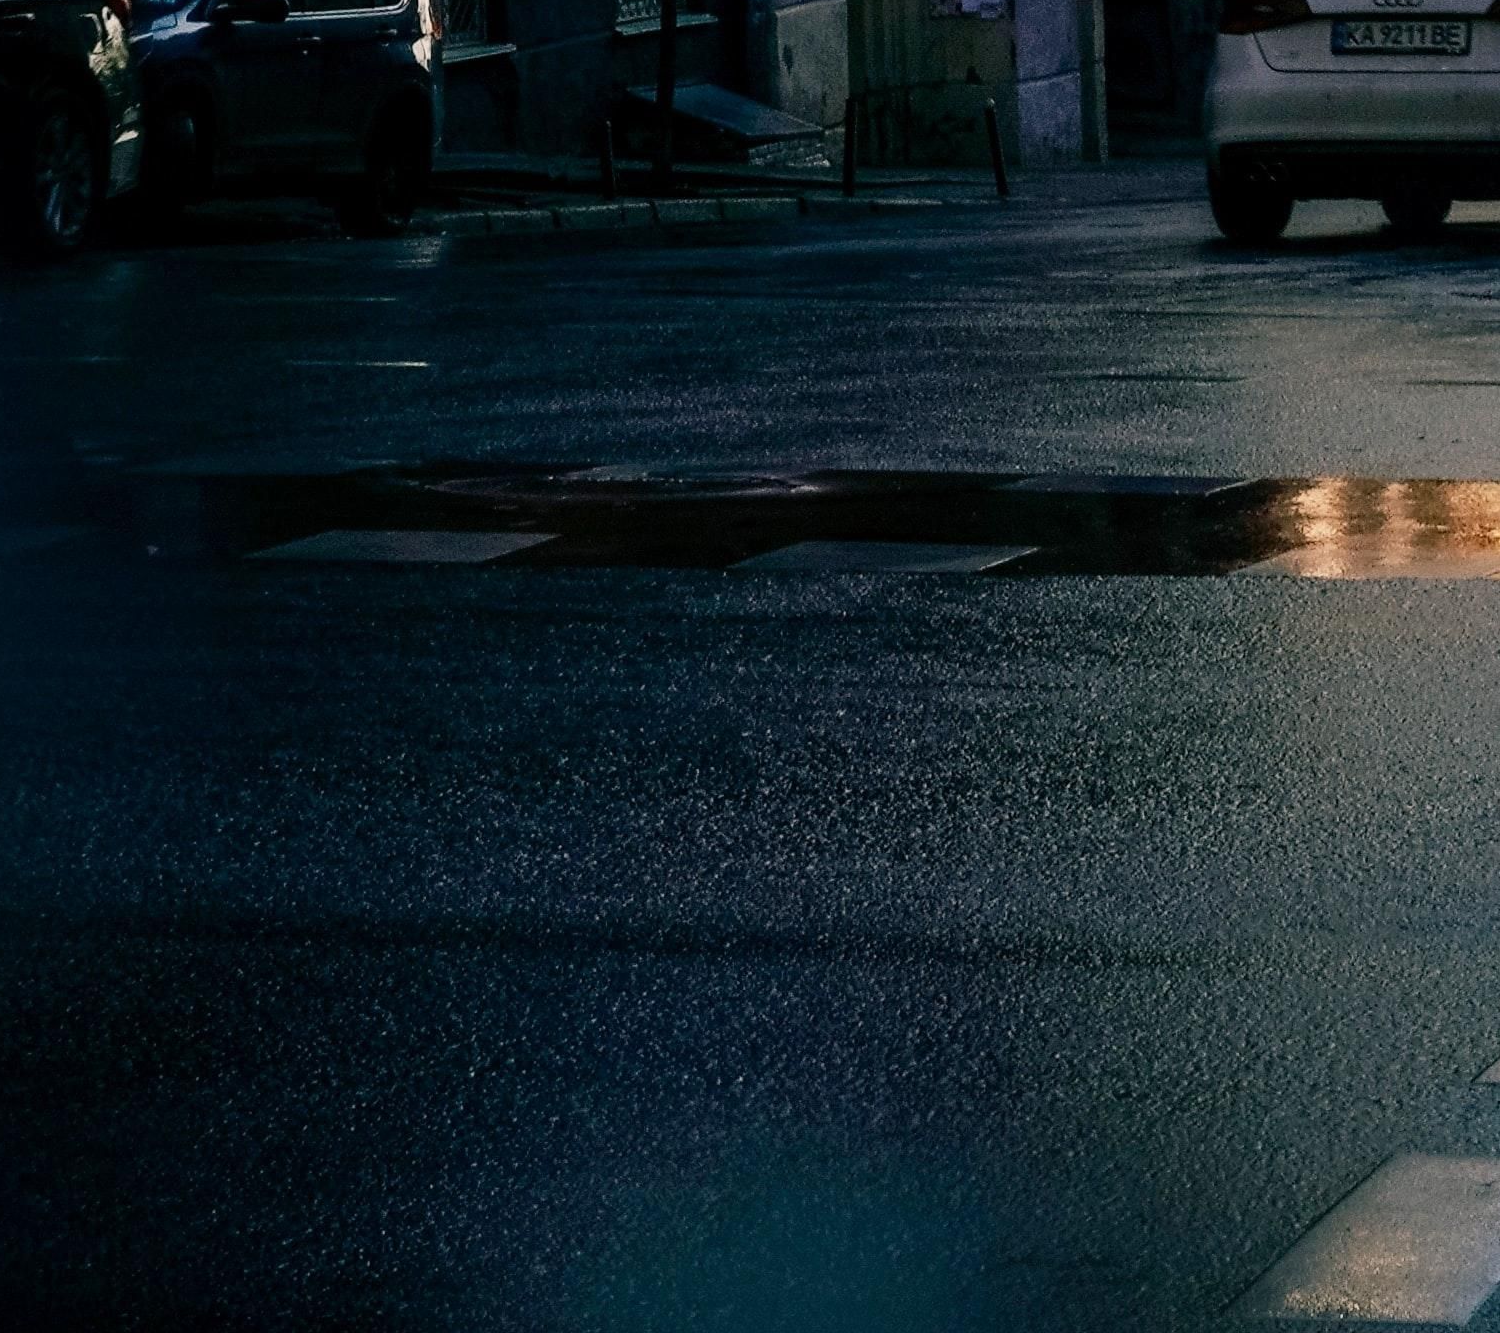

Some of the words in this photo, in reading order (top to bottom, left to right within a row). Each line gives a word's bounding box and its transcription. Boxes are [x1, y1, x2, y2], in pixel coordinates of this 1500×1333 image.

[1347, 24, 1375, 46] KA
[1380, 24, 1427, 46] 9211
[1431, 24, 1461, 46] BE
